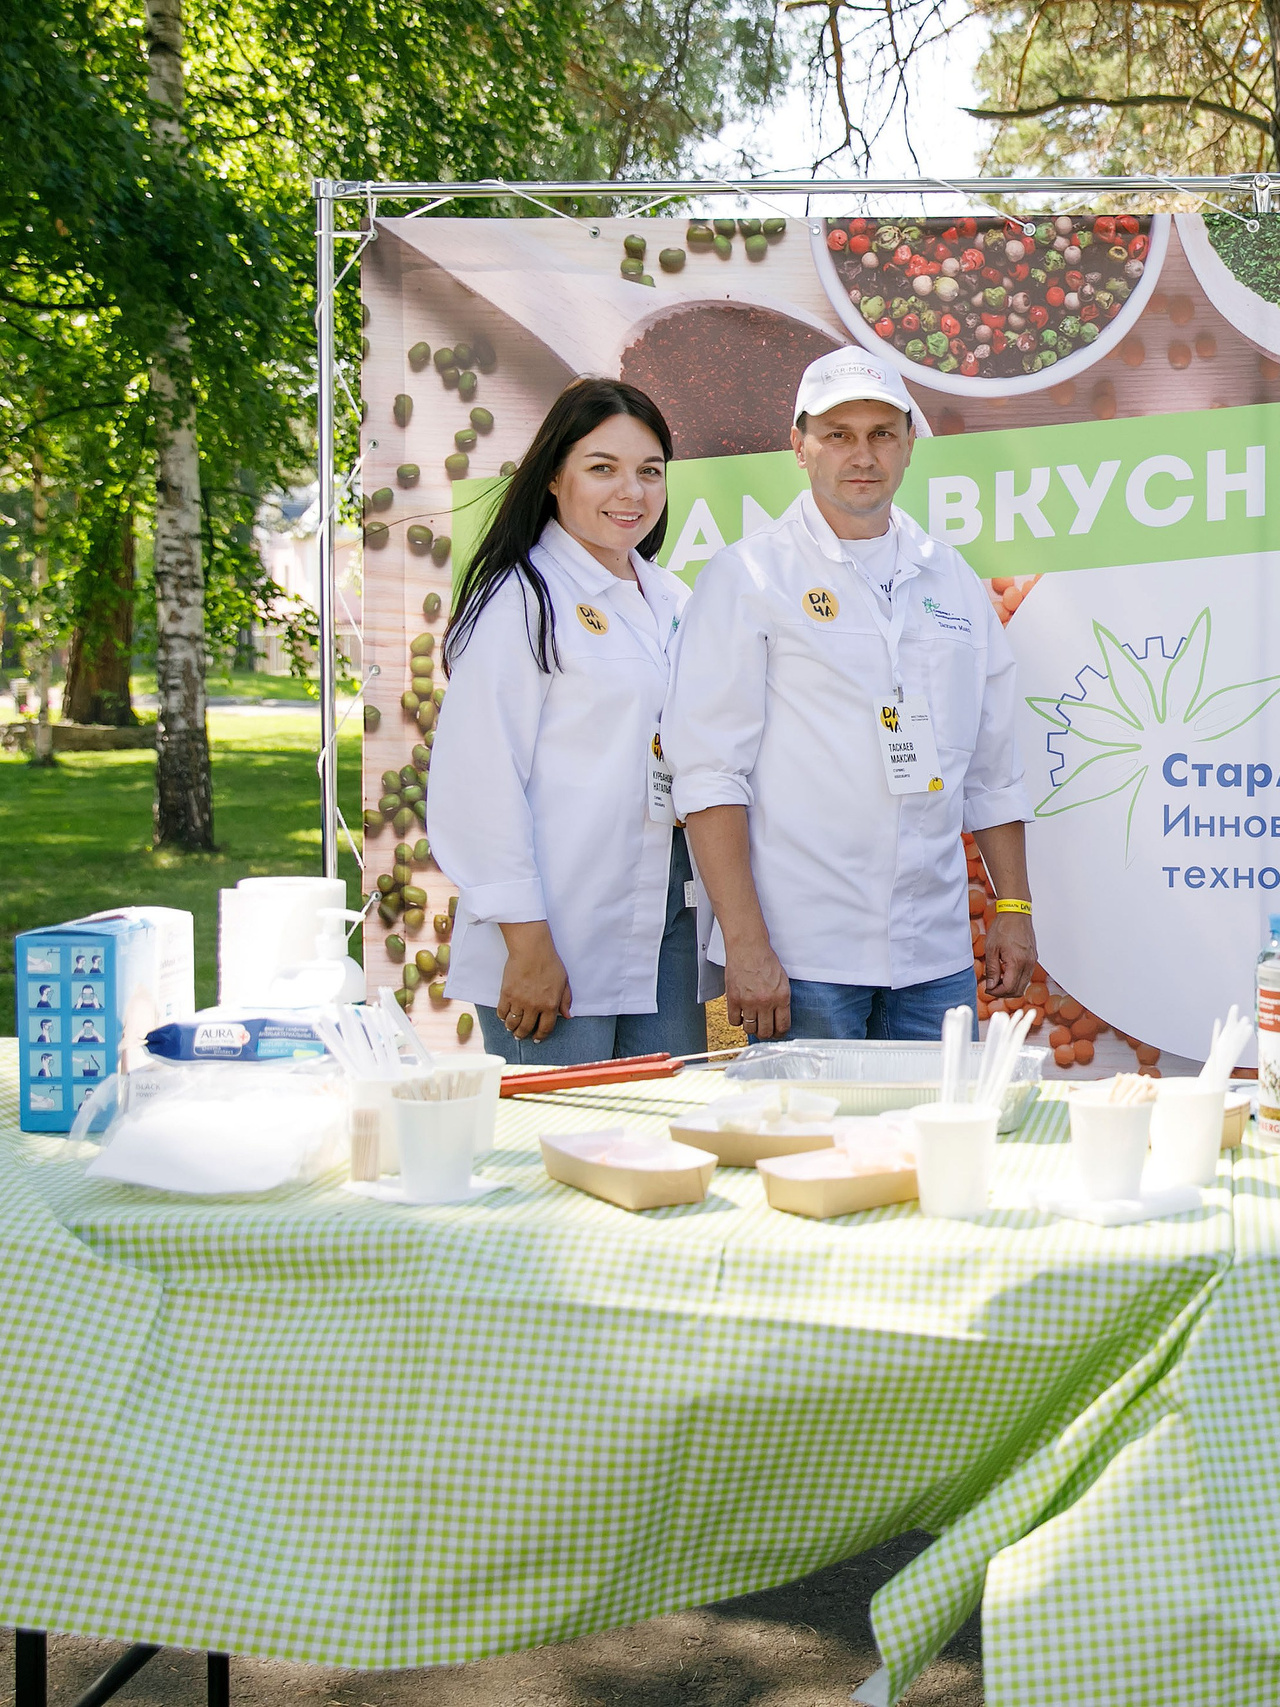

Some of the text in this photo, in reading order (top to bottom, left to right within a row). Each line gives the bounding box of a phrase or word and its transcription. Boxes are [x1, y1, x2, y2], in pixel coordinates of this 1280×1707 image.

[888, 742, 914, 752] ТАСКАЕВ
[890, 753, 917, 763] МАКСИМ
[200, 1029, 234, 1039] AURA
